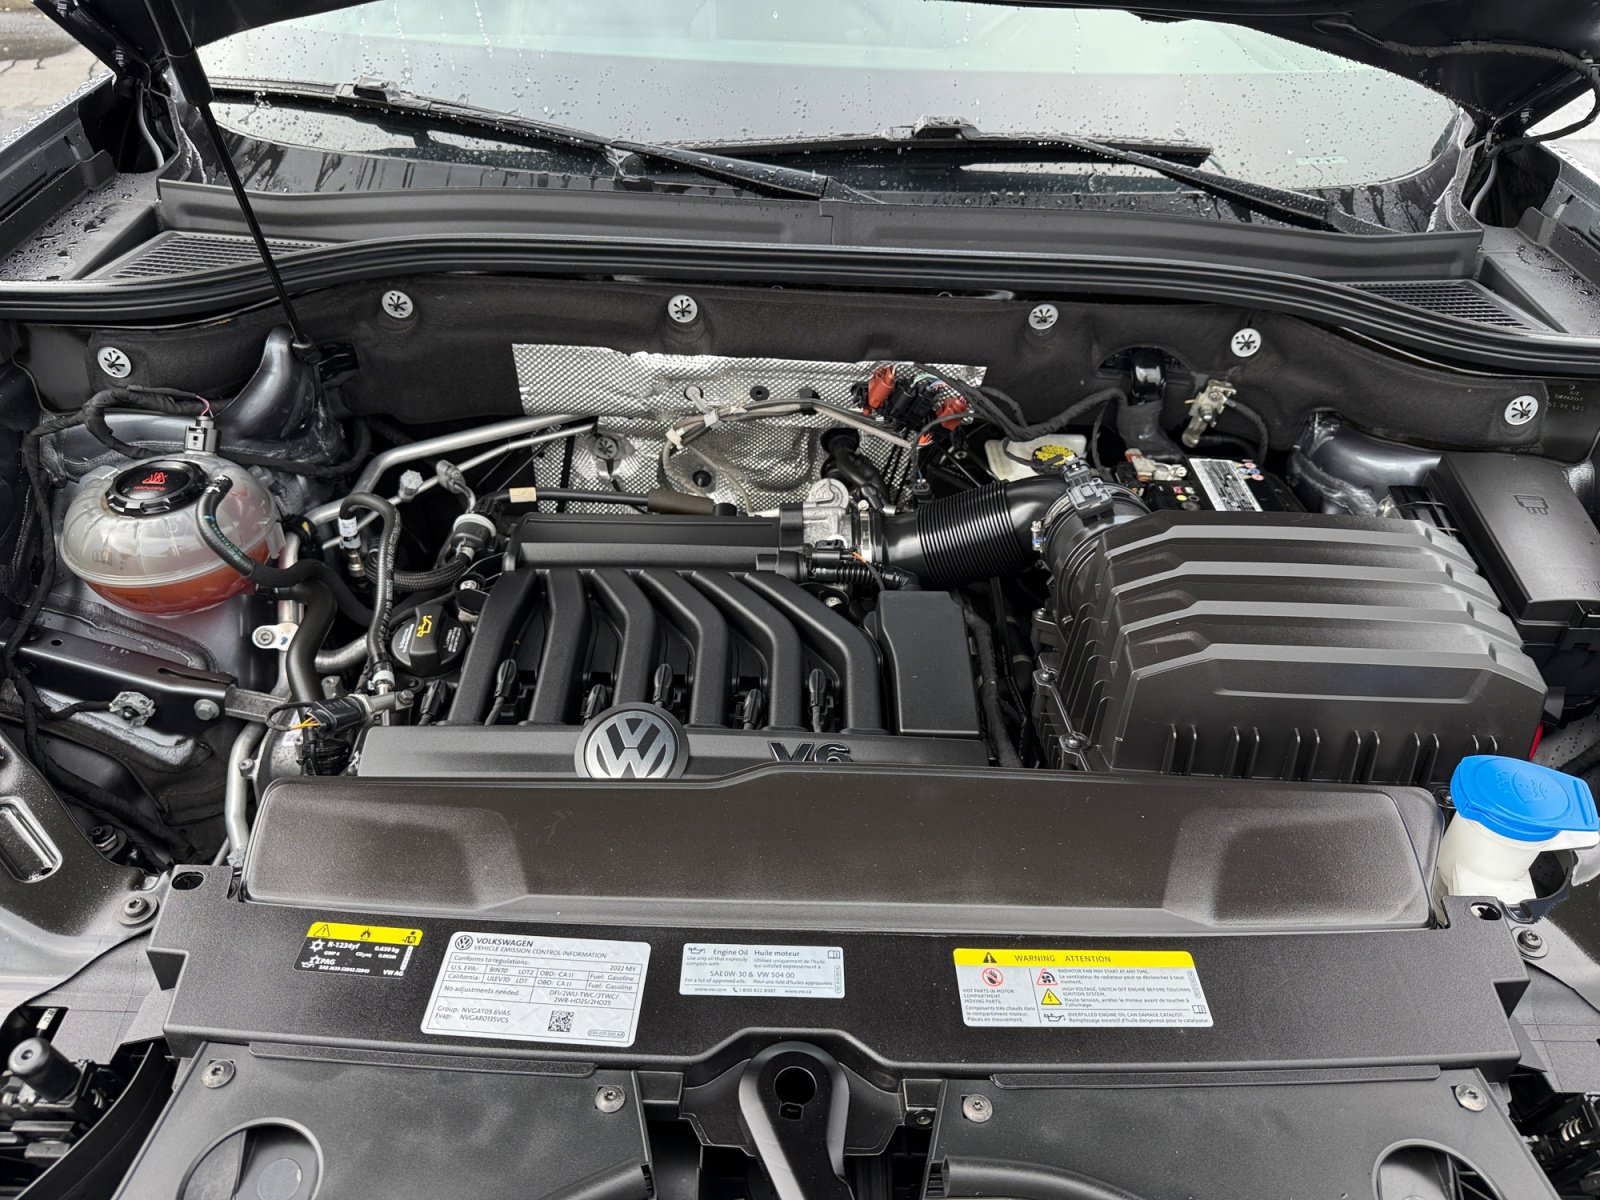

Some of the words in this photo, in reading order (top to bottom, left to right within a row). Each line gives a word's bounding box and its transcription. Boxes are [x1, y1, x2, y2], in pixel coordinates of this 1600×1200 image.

[768, 741, 851, 762] V6
[328, 942, 360, 950] R-1234yf
[476, 938, 534, 947] VOLKSWAGEN
[454, 986, 494, 994] adjustments
